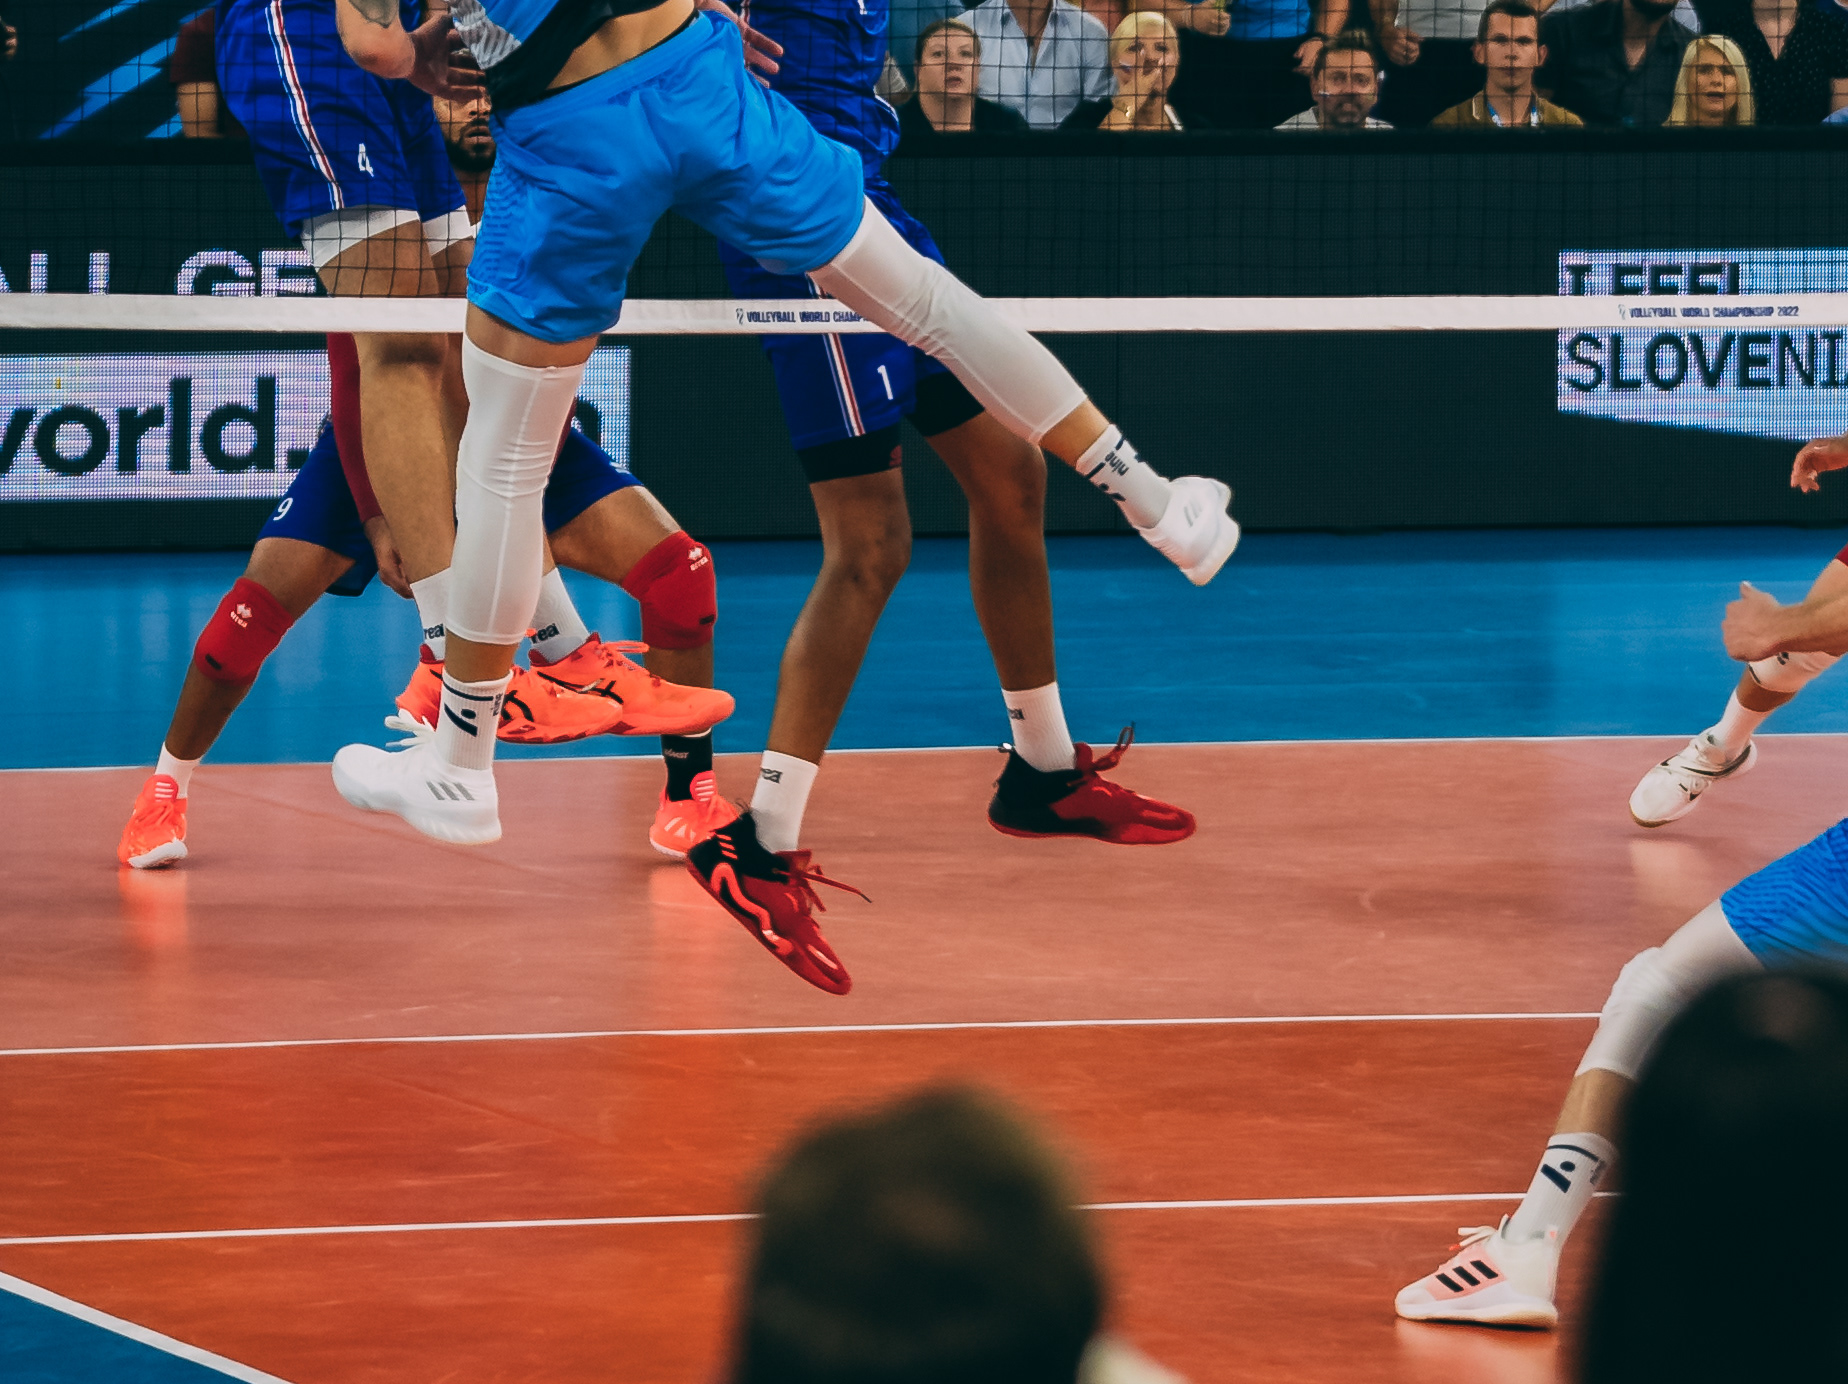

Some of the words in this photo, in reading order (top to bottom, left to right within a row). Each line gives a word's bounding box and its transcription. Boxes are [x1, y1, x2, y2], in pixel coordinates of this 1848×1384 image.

[747, 311, 797, 323] VOLLEYBALL
[799, 311, 831, 323] WORLD
[1566, 330, 1848, 392] SLOVENI
[877, 364, 894, 401] 1
[272, 497, 294, 521] 9
